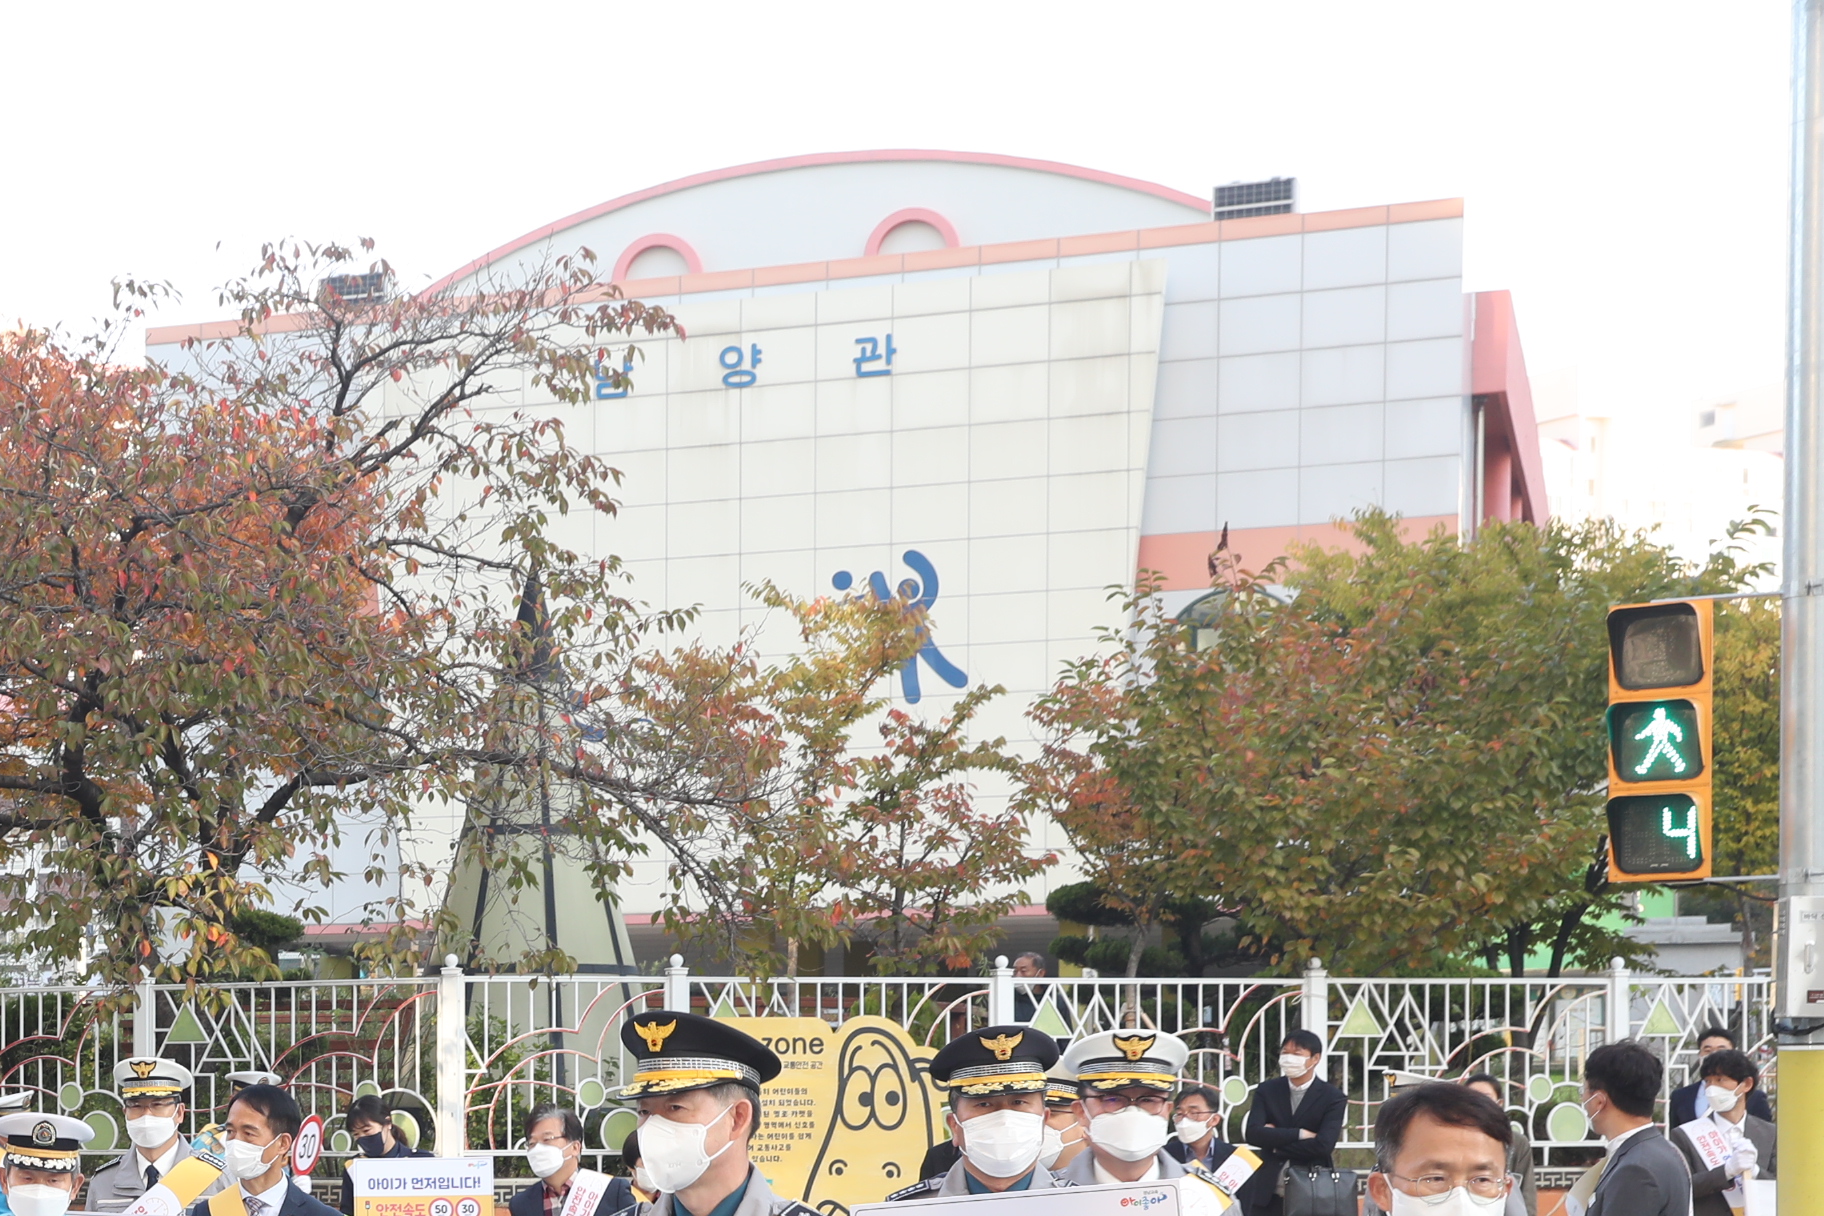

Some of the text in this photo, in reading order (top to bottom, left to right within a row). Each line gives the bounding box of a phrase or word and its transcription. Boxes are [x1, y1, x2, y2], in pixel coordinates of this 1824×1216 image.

[1662, 806, 1697, 859] 4
[298, 1133, 317, 1159] 30
[368, 1176, 481, 1190] 아이가 먼저입니다!
[435, 1205, 448, 1214] 50
[462, 1204, 475, 1214] 30
